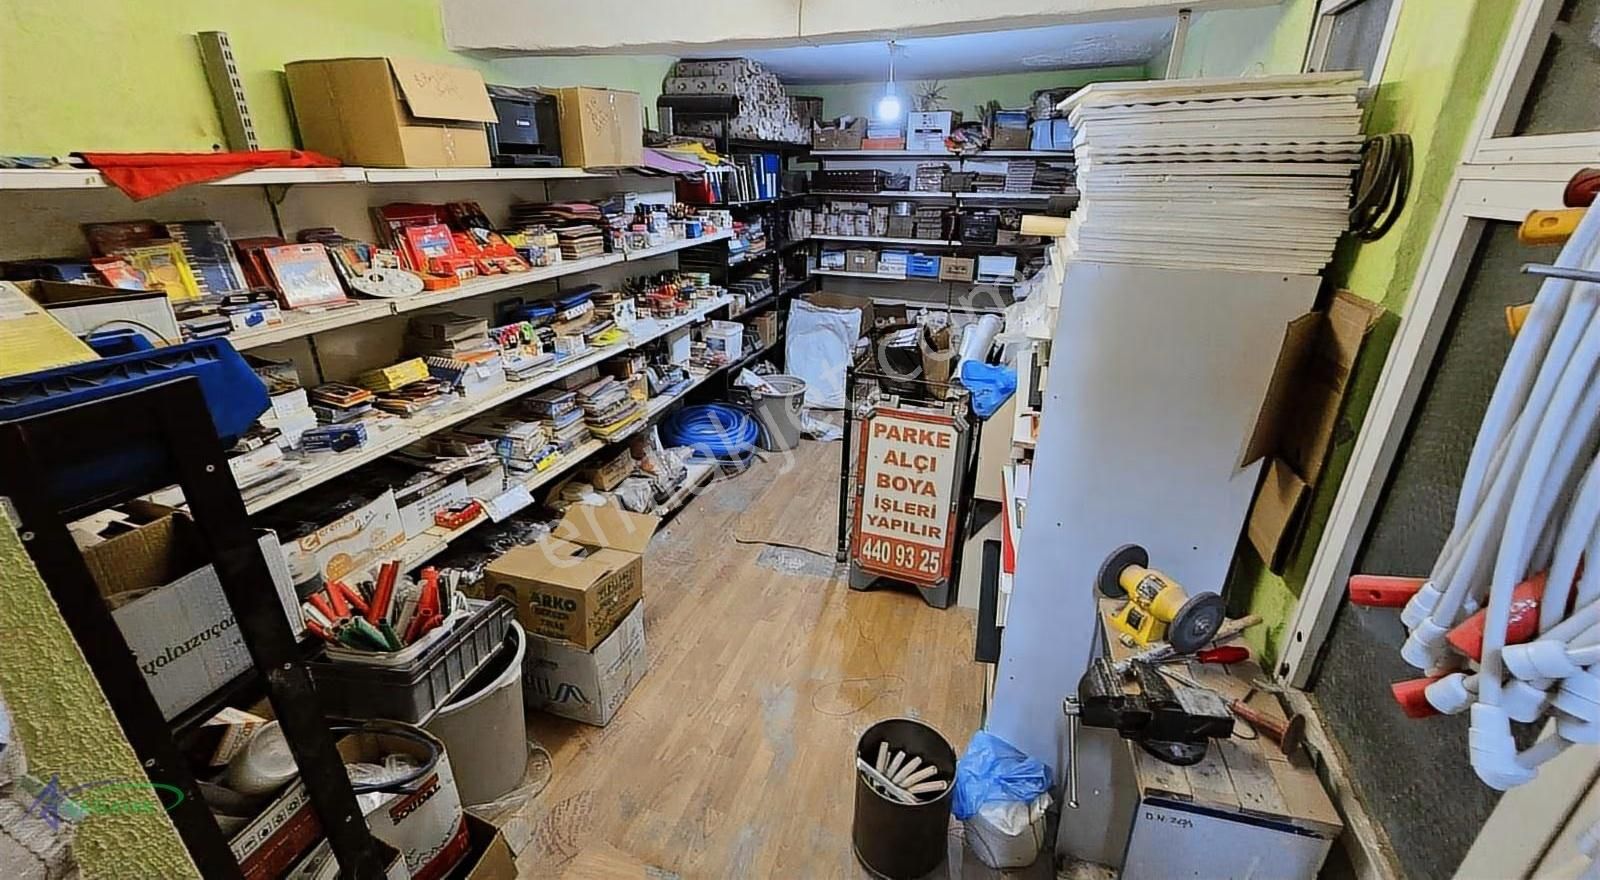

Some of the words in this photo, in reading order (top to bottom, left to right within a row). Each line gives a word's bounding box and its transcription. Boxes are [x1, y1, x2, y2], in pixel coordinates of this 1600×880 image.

[873, 422, 951, 448] PARKE
[883, 450, 937, 473] ALÇI
[876, 473, 937, 497] BOYA
[874, 494, 937, 519] İŞLERİ
[866, 514, 942, 539] YAPILIR
[862, 538, 891, 564] 440
[895, 546, 915, 568] 93
[919, 550, 940, 574] 25
[529, 591, 577, 612] ARKO
